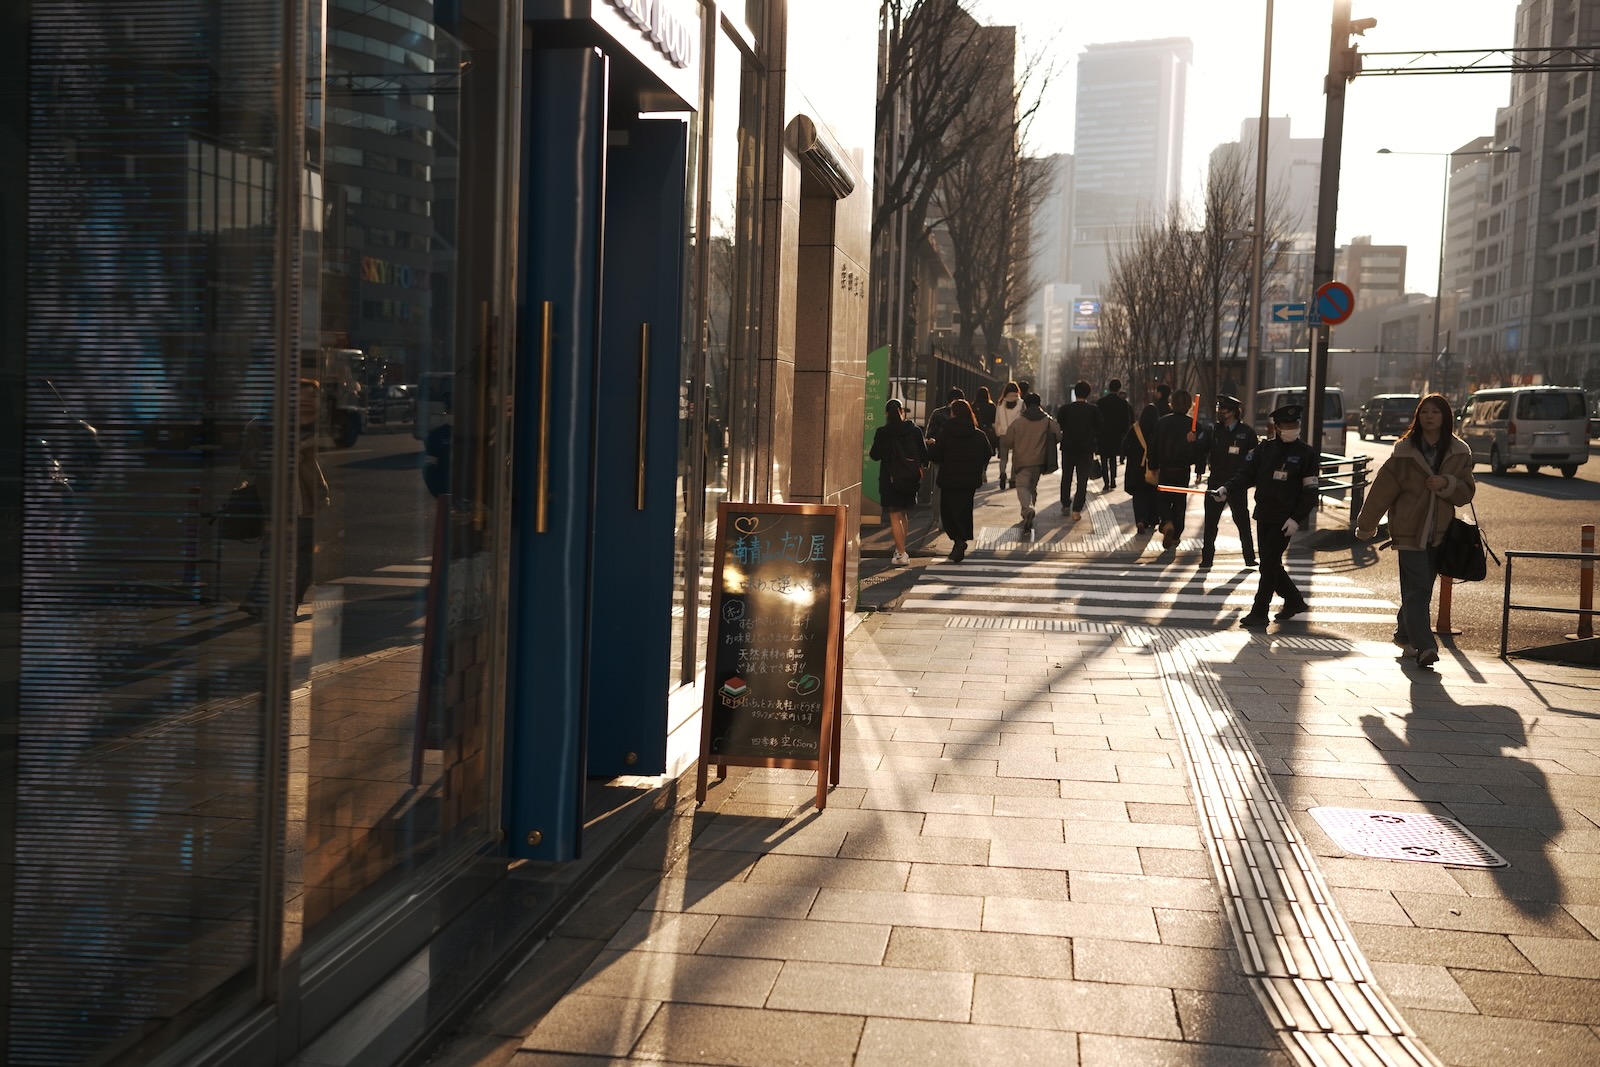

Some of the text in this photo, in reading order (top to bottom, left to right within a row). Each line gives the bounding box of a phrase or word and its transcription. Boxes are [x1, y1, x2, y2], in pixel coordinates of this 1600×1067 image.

[738, 647, 805, 661] 天然素材の商品
